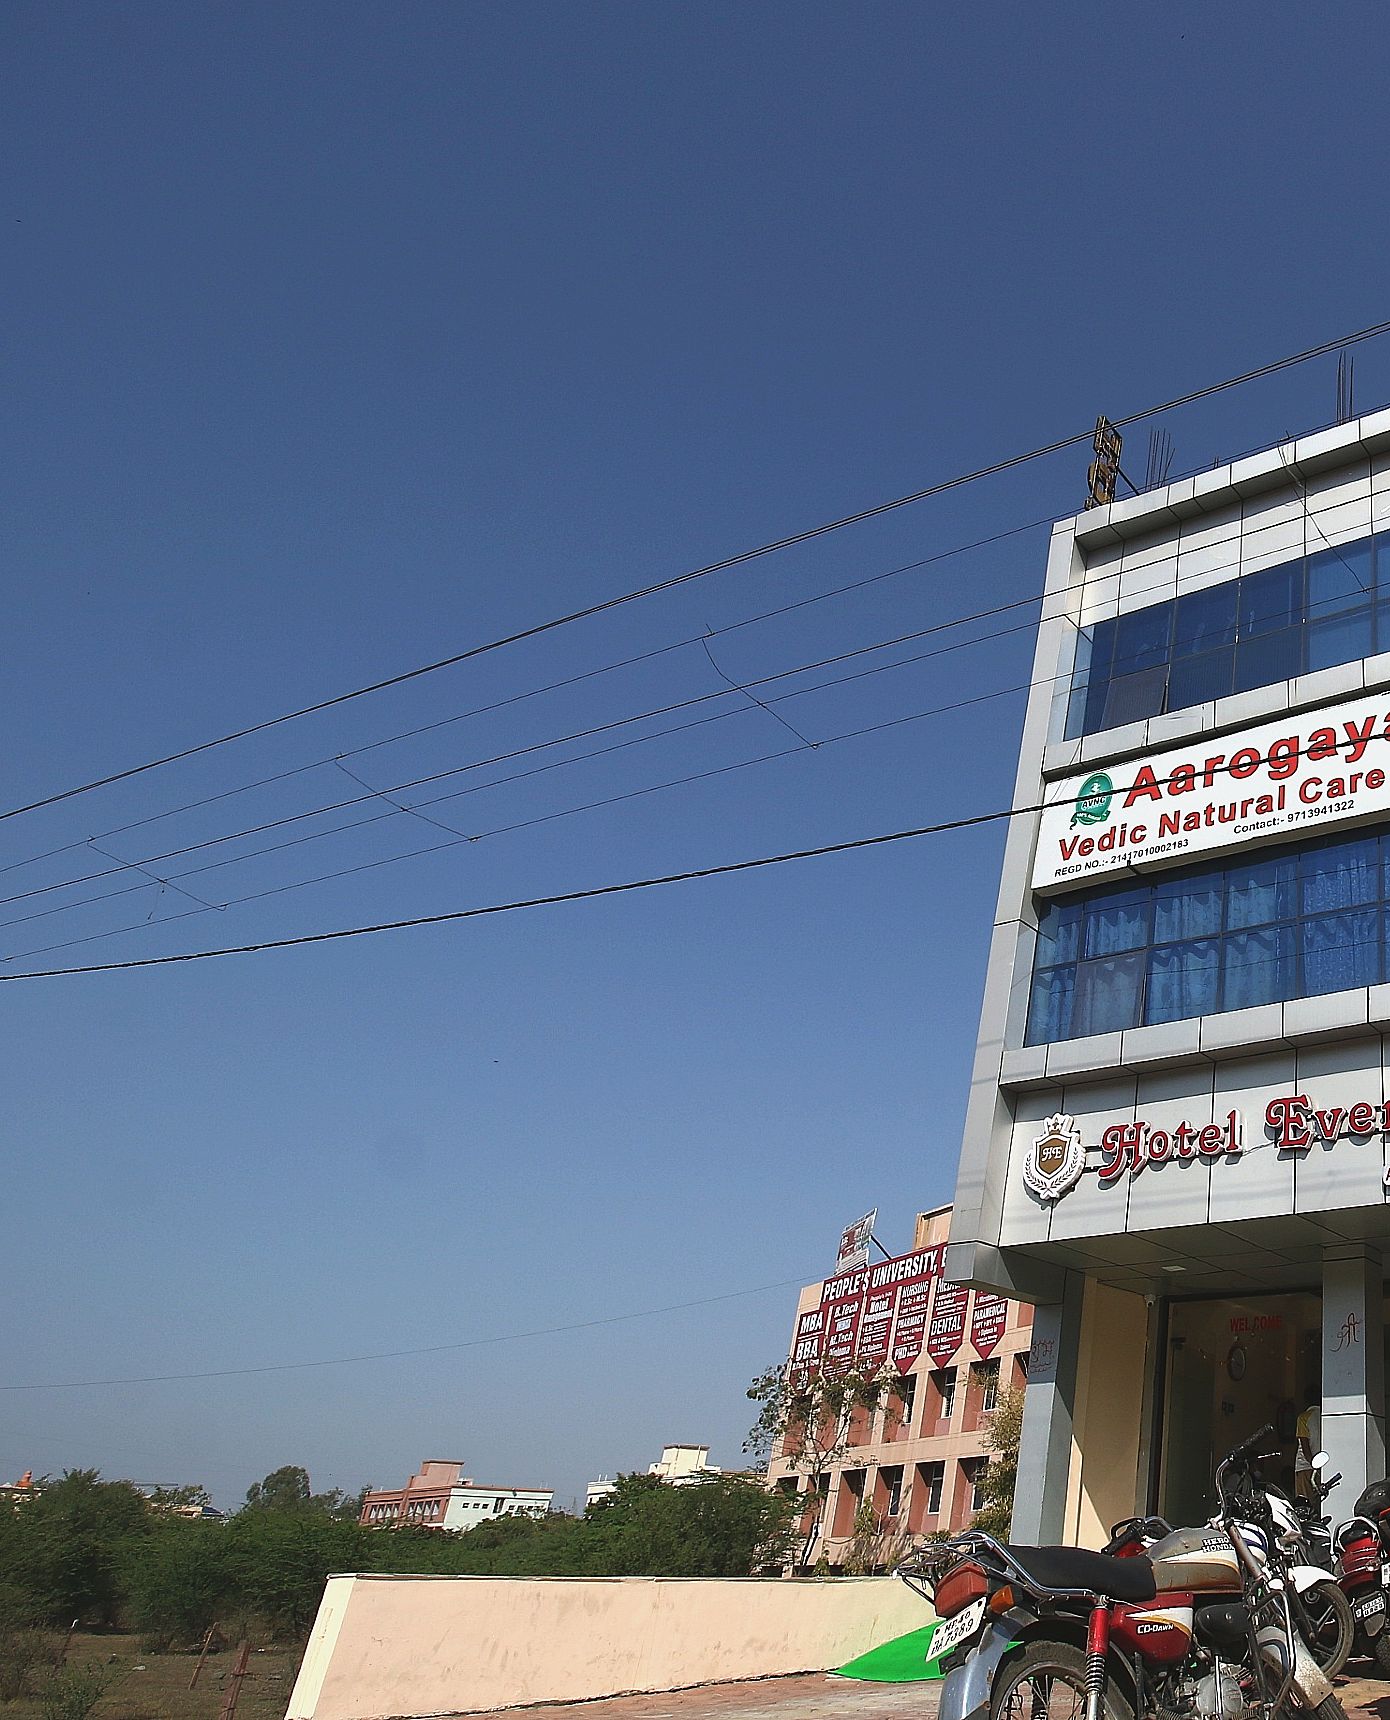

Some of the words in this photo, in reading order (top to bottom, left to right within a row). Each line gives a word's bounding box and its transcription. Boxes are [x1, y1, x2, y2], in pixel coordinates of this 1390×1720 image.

[1082, 796, 1106, 808] AVNC
[1287, 800, 1355, 823] 9713941322
[1059, 823, 1147, 861] Vedic
[1158, 785, 1285, 838] Natural
[1299, 768, 1385, 803] Care
[1055, 864, 1082, 877] REGD
[1098, 1108, 1242, 1180] Hotel
[823, 1270, 870, 1302] PEOPLE'S
[872, 1250, 938, 1288] UNIVERSITY,
[800, 1312, 823, 1334] MBA
[931, 1315, 961, 1336] DENTAL
[796, 1339, 818, 1361] BBA
[1202, 1544, 1235, 1553] HONDA
[1203, 1536, 1230, 1546] HERO
